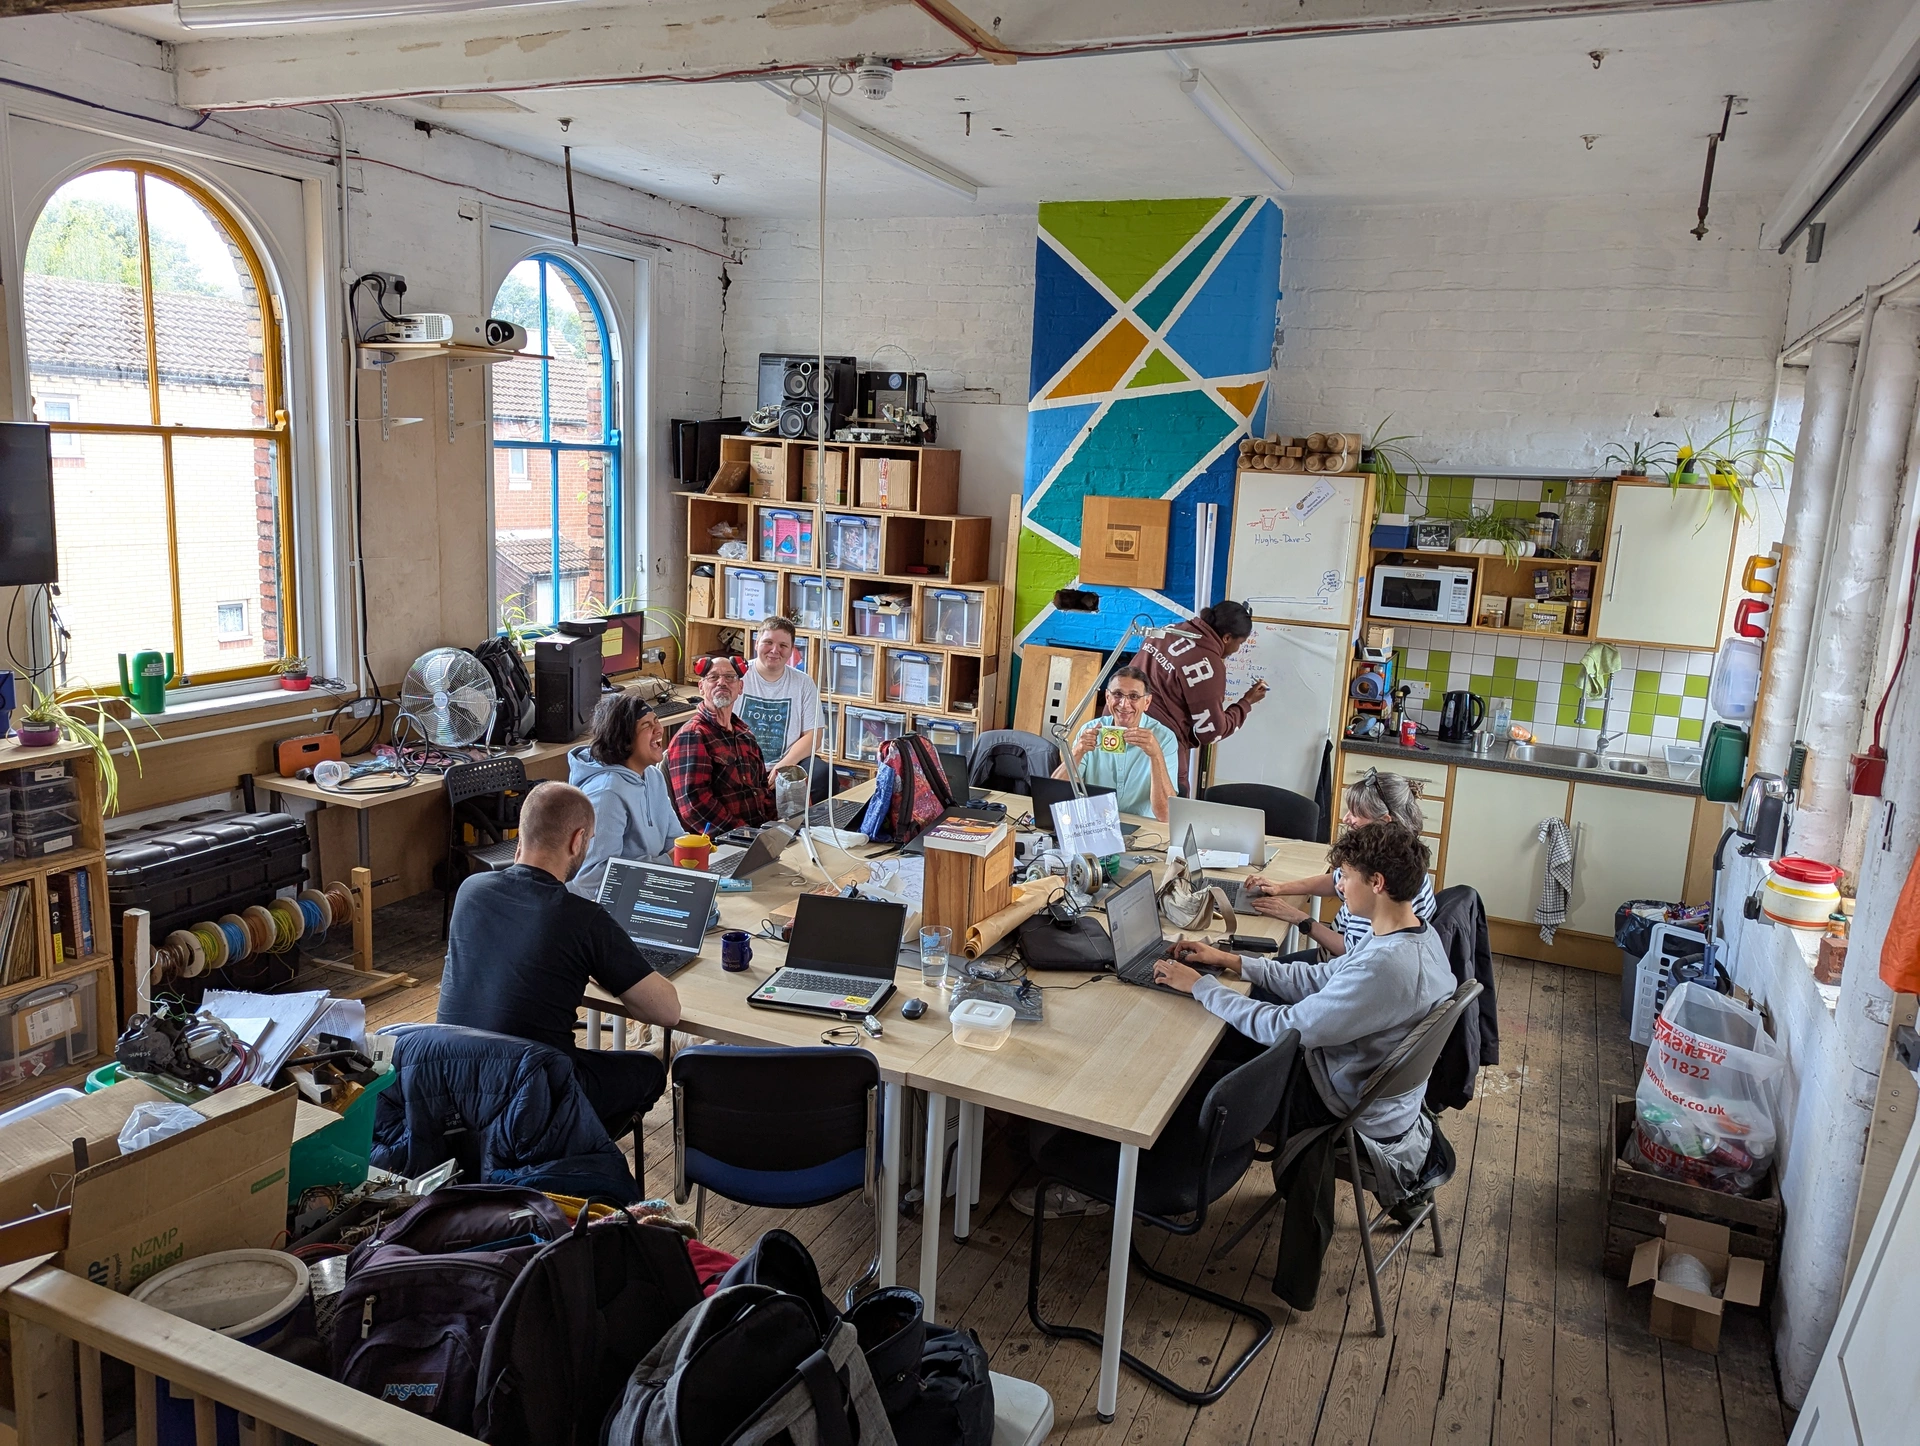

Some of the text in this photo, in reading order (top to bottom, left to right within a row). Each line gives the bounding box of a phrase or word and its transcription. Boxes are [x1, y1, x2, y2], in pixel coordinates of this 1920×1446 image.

[1141, 642, 1176, 674] WEST COAST
[747, 710, 782, 722] TOKYO
[1104, 737, 1116, 746] 60
[52, 911, 60, 925] C++
[131, 1227, 178, 1261] NZMP
[130, 1242, 184, 1280] Salted
[380, 1383, 439, 1401] JANSPORT
